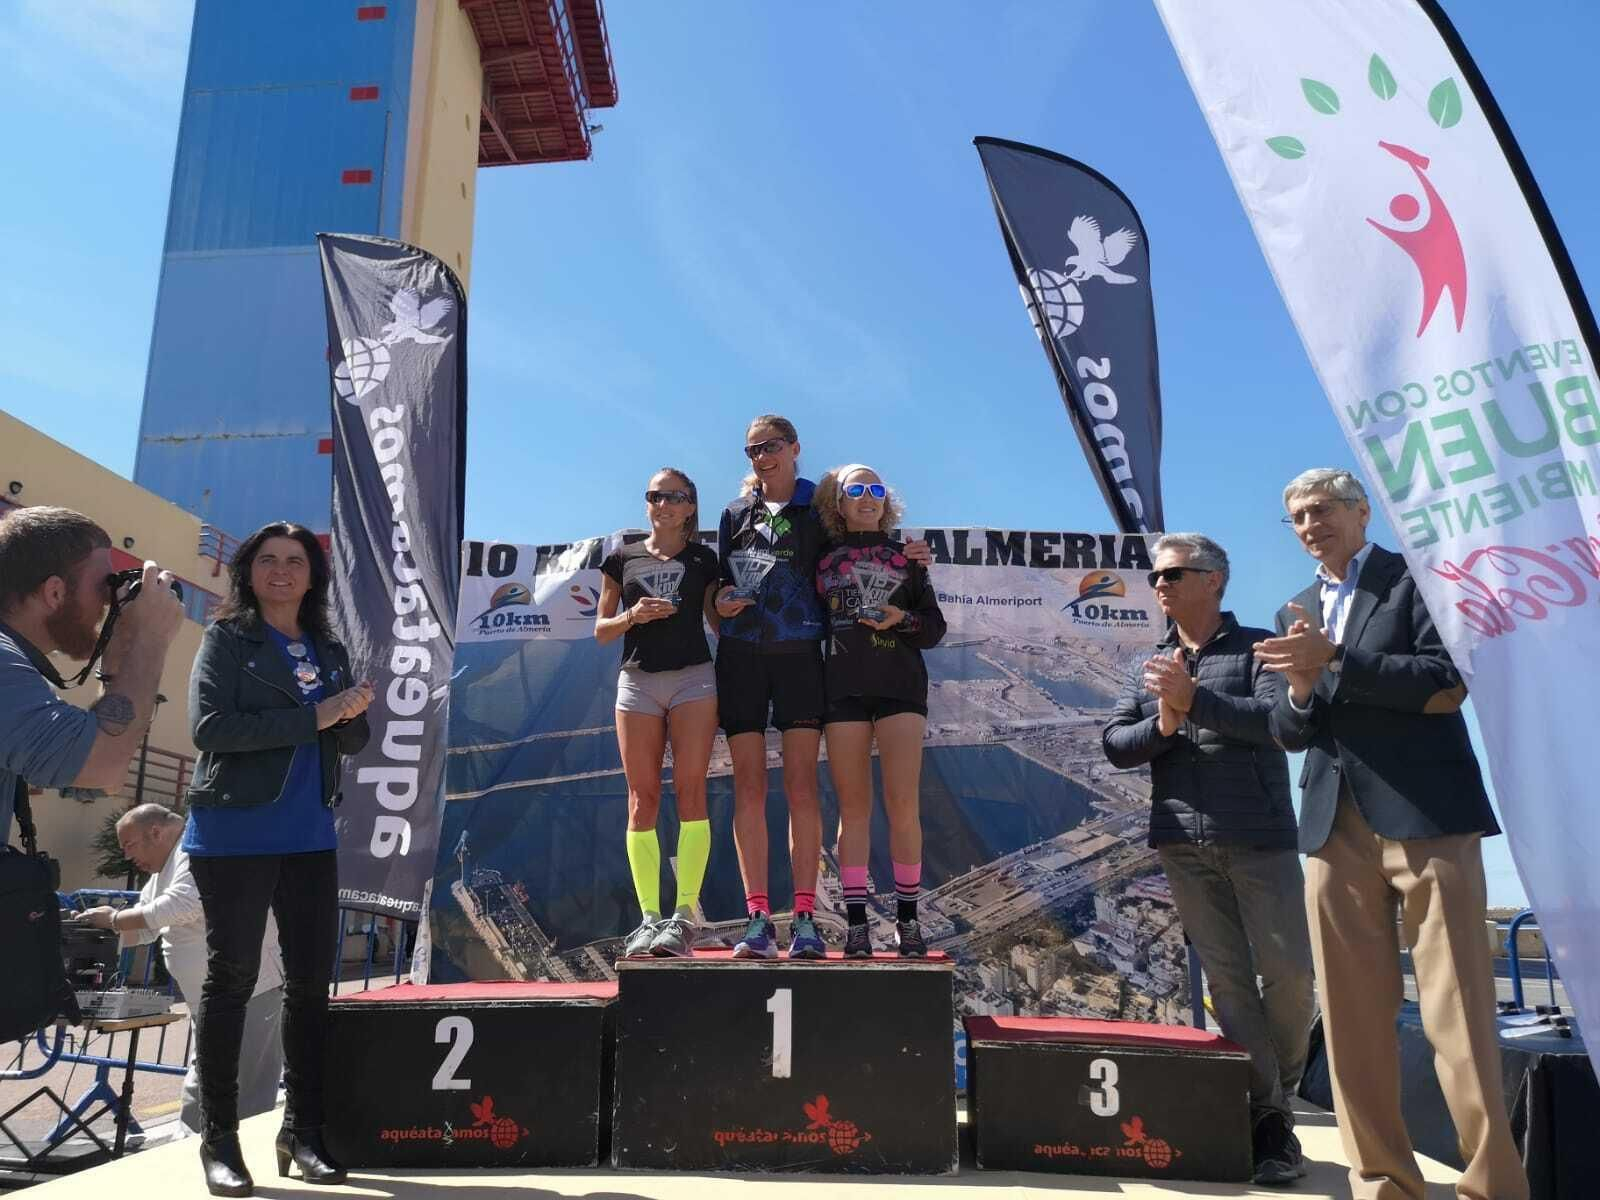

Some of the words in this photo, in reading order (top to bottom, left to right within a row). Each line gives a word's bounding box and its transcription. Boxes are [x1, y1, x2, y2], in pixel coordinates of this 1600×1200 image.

[924, 529, 1153, 570] ALMERIA
[479, 612, 551, 629] 10km
[976, 594, 1043, 608] Almeriport
[1071, 604, 1149, 620] 10km
[432, 1015, 474, 1090] 2
[766, 988, 792, 1078] 1
[1089, 1058, 1120, 1117] 3
